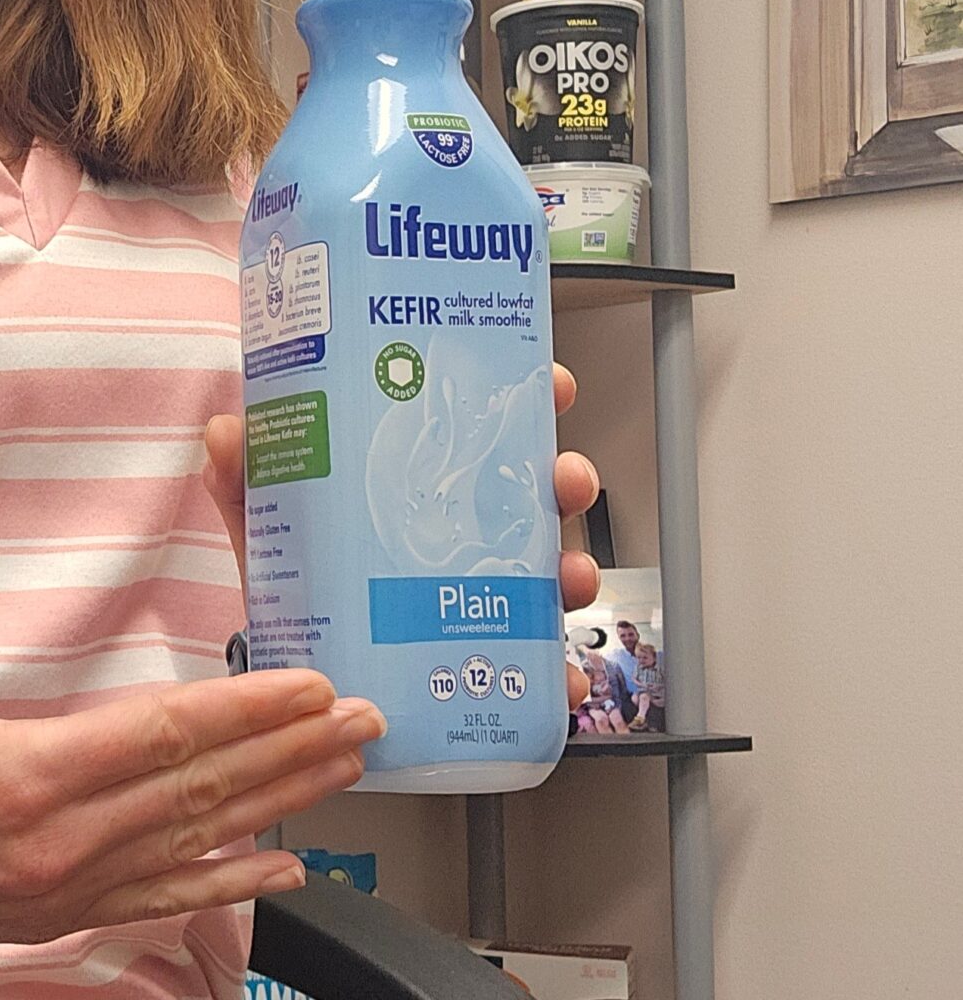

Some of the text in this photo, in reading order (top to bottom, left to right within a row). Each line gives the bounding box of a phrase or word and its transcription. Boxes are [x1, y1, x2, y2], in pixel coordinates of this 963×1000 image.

[566, 19, 598, 27] VANILLA
[528, 41, 629, 74] OIKOS
[557, 72, 610, 95] PRO
[561, 94, 607, 116] 23g
[413, 117, 466, 128] PROBIOTIC
[558, 116, 609, 128] PROTEIN
[418, 133, 471, 164] LACTOSE FREE
[251, 183, 298, 223] Lifeway
[365, 202, 532, 273] Lifeway
[269, 246, 281, 269] 12
[444, 291, 534, 309] cultured lowfat
[368, 296, 443, 325] KEFIR
[448, 309, 531, 328] milk smoothie
[382, 344, 417, 359] NO SUGAR
[386, 386, 416, 399] ADDED
[295, 401, 318, 411] shown
[291, 414, 315, 425] cultures
[439, 584, 509, 619] Plain
[311, 615, 331, 626] from
[442, 619, 509, 634] unsweetened
[305, 629, 321, 641] with
[432, 679, 453, 694] 110
[469, 669, 488, 687] 12
[504, 676, 522, 694] 11g
[464, 713, 475, 727] 32
[481, 729, 488, 745] (1
[490, 729, 519, 747] QUART)
